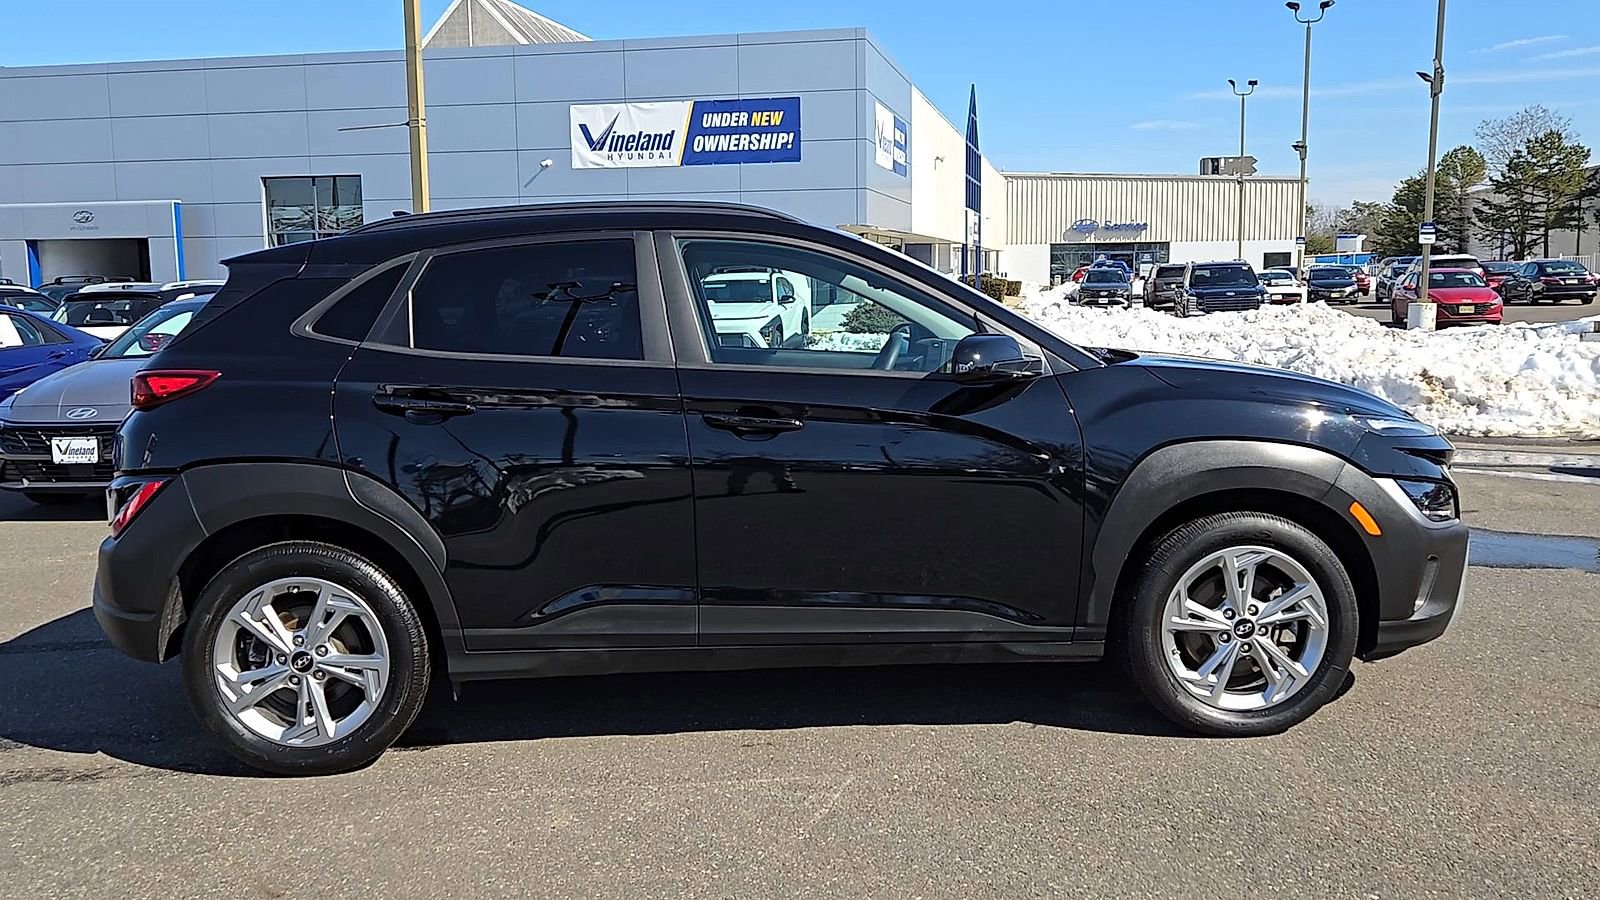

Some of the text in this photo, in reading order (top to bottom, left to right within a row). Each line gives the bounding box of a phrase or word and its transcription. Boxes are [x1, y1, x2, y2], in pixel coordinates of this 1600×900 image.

[702, 110, 784, 128] UNDER NEW
[578, 112, 675, 152] Vineland
[693, 132, 794, 152] OWNERSHIP!
[607, 151, 672, 161] HYUNDAI
[1104, 220, 1148, 232] Service
[56, 441, 95, 455] Vineland
